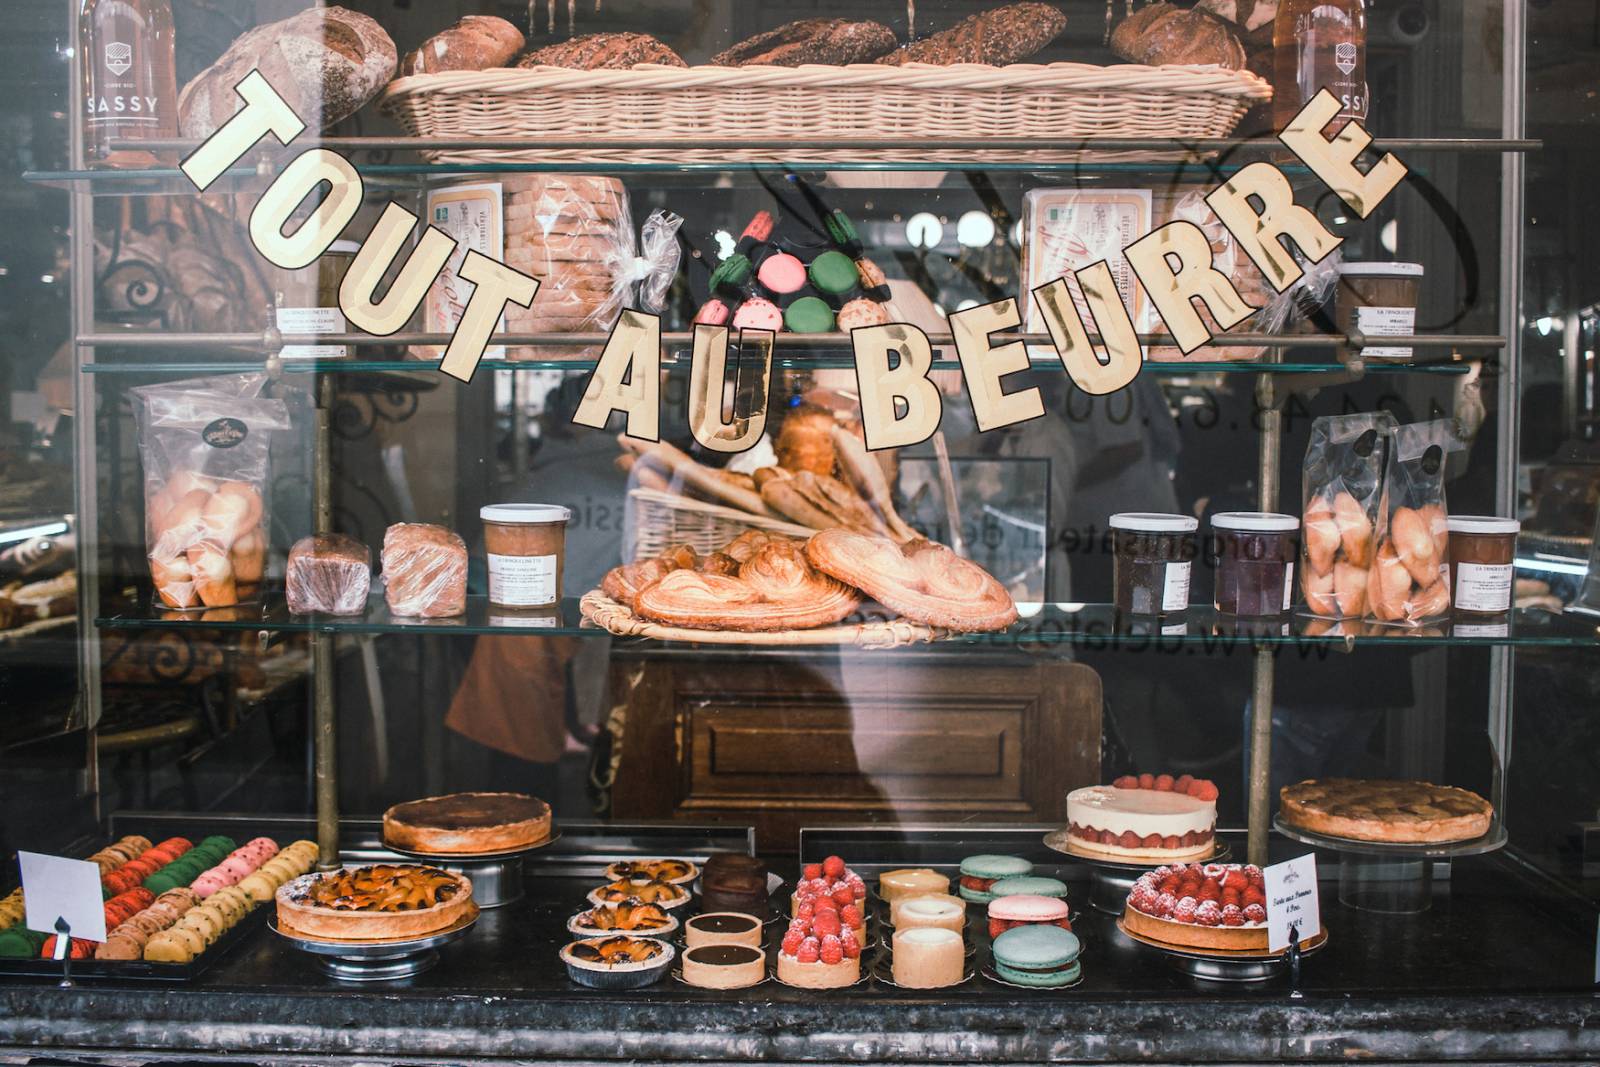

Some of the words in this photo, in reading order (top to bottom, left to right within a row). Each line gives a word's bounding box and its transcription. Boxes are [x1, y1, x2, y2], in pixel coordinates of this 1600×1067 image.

[87, 96, 158, 113] SASSY
[179, 68, 541, 384] TOUT
[571, 307, 775, 453] AU
[851, 86, 1409, 452] BEURRE
